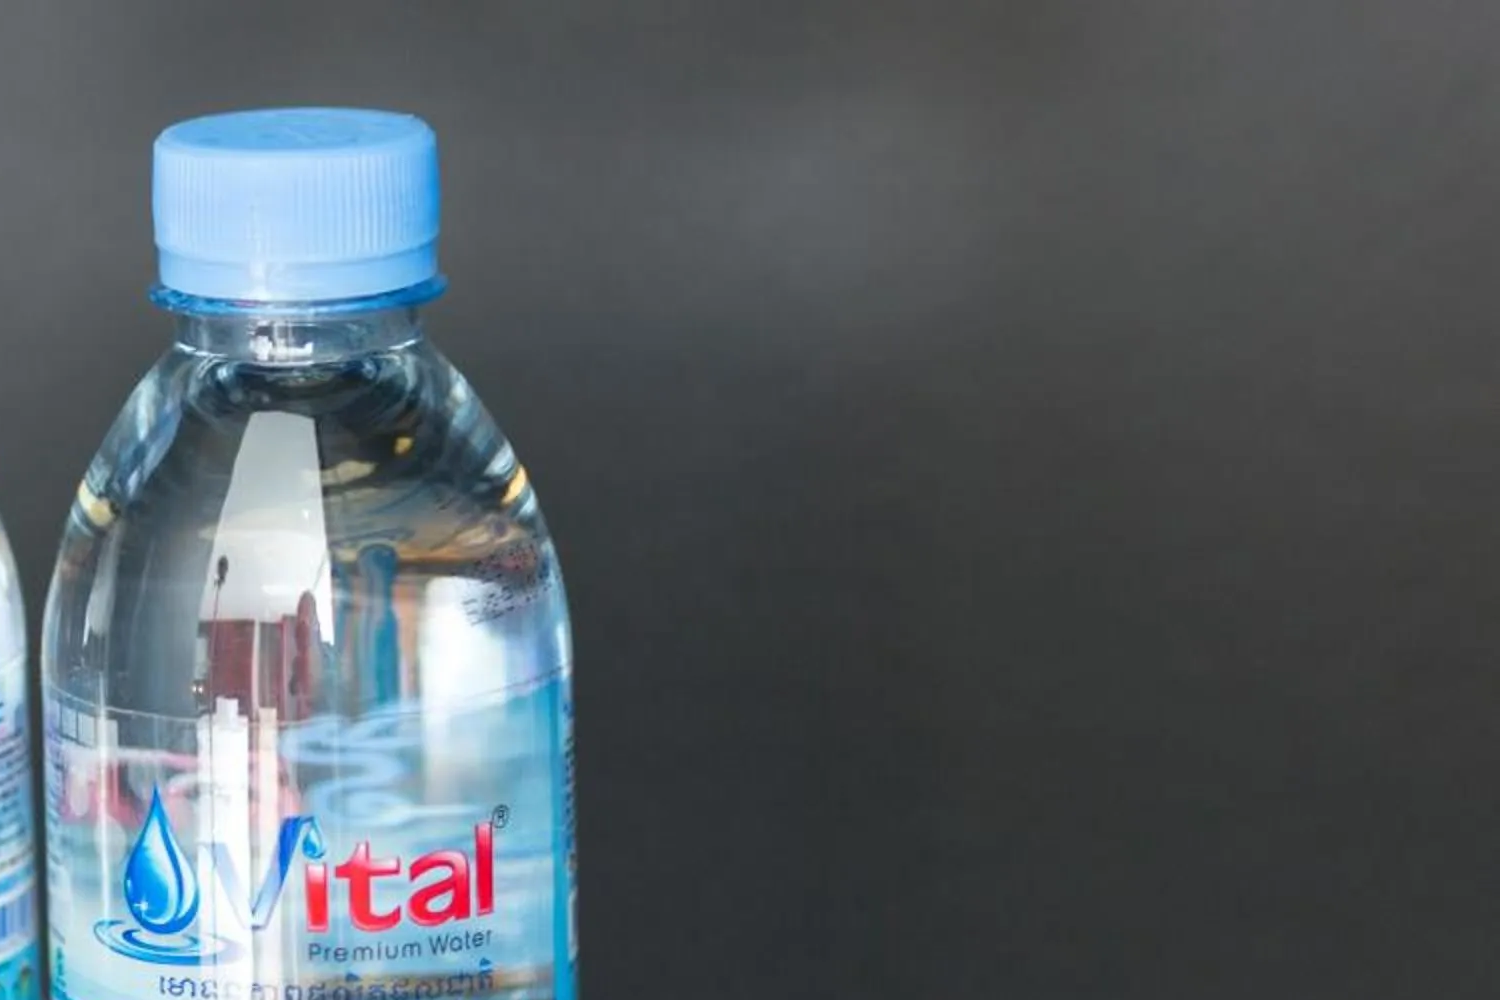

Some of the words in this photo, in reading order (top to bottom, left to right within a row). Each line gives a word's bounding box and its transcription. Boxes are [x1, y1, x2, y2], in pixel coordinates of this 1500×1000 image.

[197, 814, 495, 933] Vital
[307, 941, 423, 963] Premium
[429, 929, 492, 956] Water
